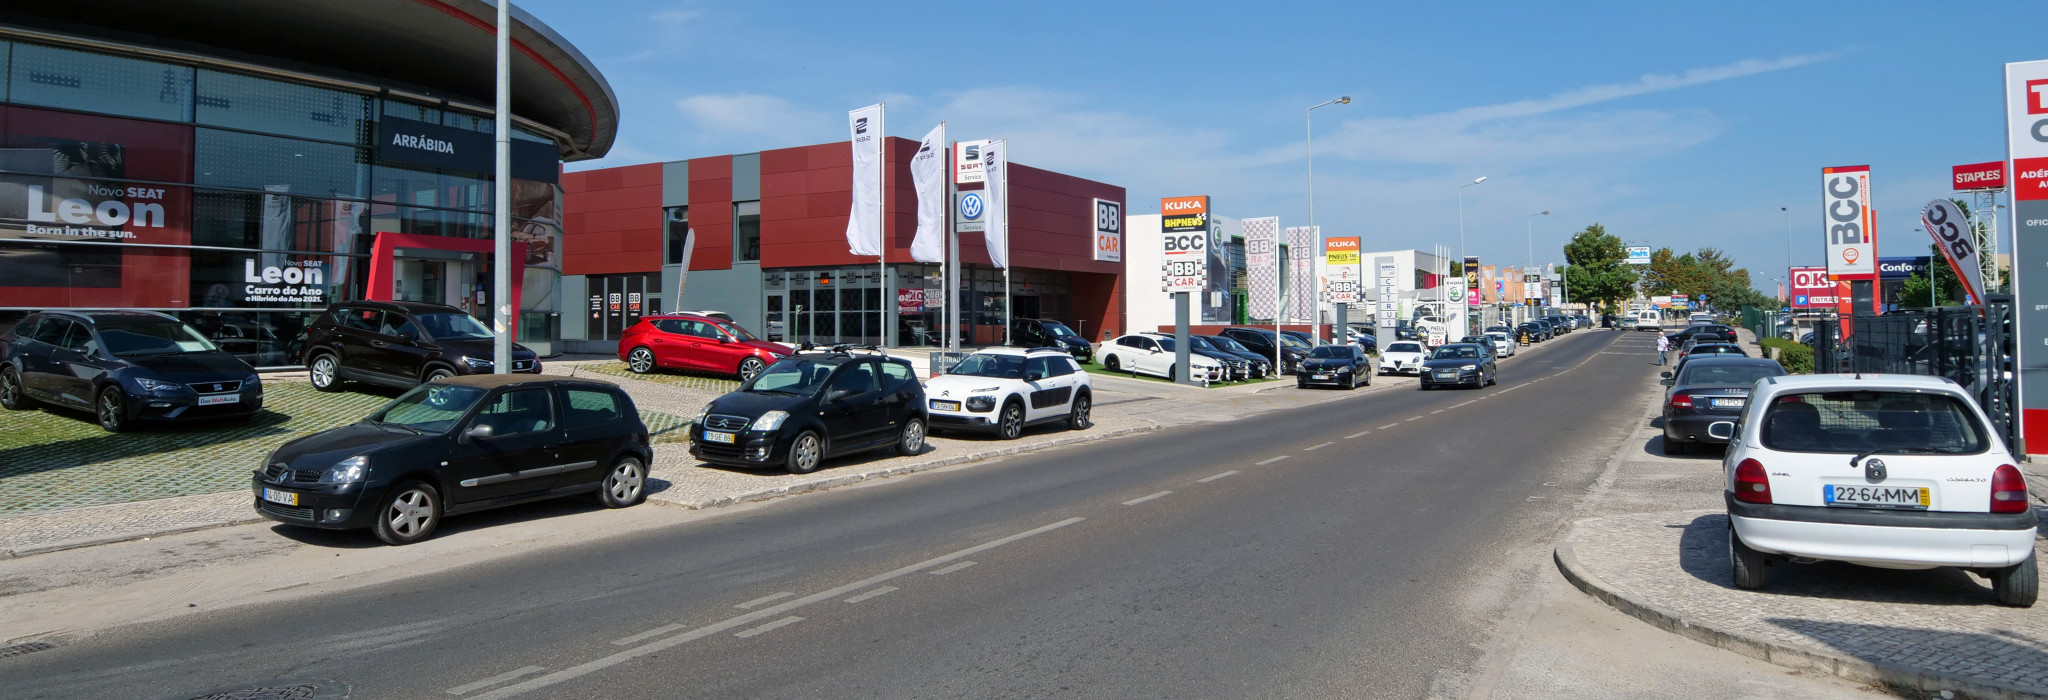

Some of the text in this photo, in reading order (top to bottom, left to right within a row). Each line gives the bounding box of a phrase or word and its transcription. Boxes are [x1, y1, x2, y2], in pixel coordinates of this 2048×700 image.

[392, 133, 454, 154] ARRÁBIDA
[1956, 170, 2000, 183] STAPLES
[88, 184, 165, 200] Novo SEAT
[28, 185, 165, 228] Leon
[1165, 201, 1202, 210] KUKA
[1828, 176, 1860, 244] BCC
[1099, 204, 1118, 230] BB
[1164, 218, 1203, 227] BHPNEUS
[27, 224, 137, 239] Born in the sun.
[1099, 235, 1118, 252] CAR
[1165, 235, 1203, 251] BCC
[245, 259, 322, 284] Leon
[1174, 262, 1194, 276] BB
[1175, 278, 1194, 286] CAR
[1336, 283, 1351, 292] BB
[245, 285, 322, 295] Carro do Ano
[611, 294, 620, 302] BB
